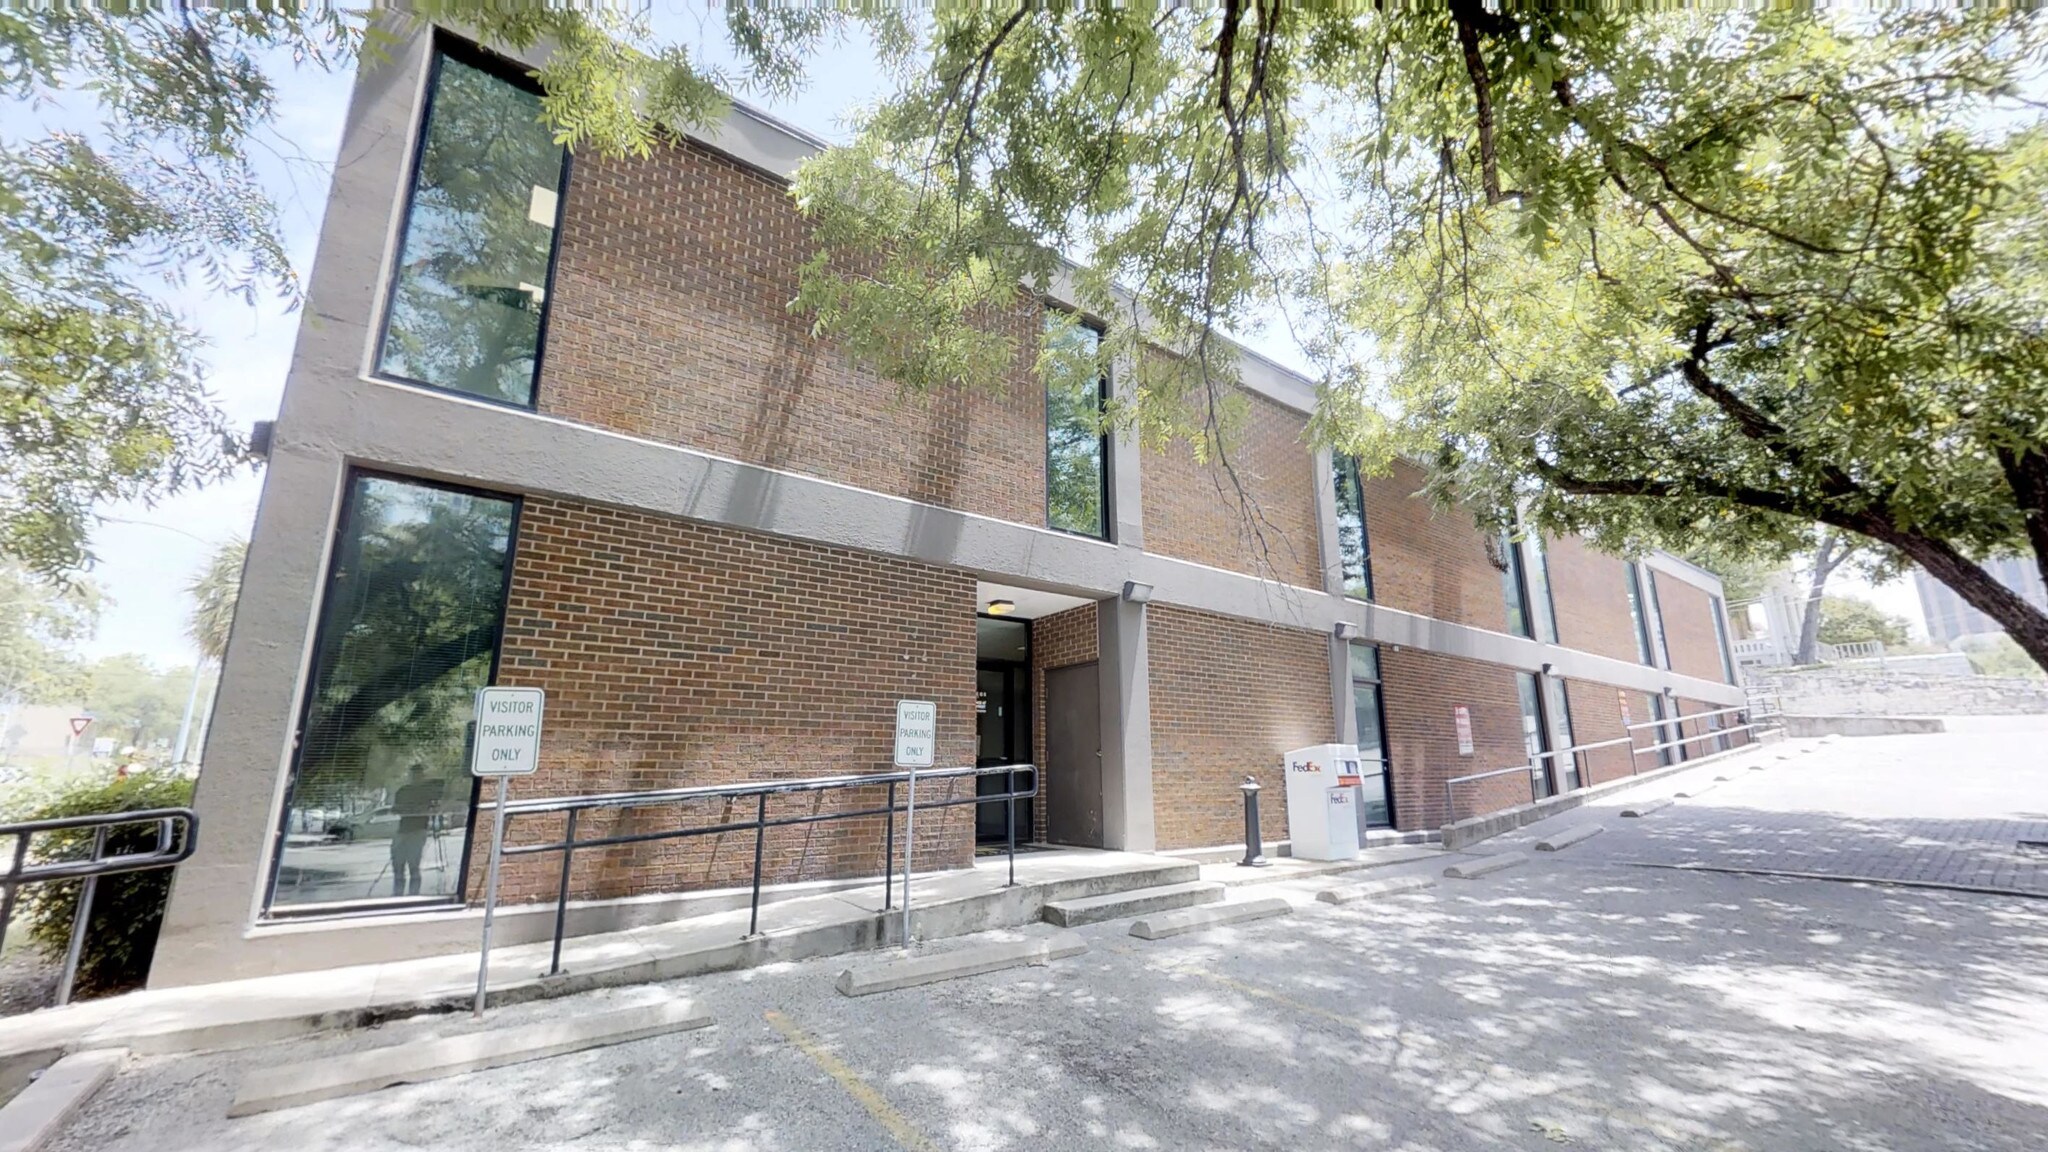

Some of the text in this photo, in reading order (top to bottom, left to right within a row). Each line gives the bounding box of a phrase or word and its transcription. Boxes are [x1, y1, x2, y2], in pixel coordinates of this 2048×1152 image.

[490, 701, 534, 714] VISITOR
[904, 710, 931, 721] VISITOR
[482, 724, 535, 738] PARKING
[900, 727, 932, 739] PARKING
[491, 748, 521, 761] ONLY
[905, 746, 924, 757] ONLY
[1292, 761, 1321, 772] FedEx
